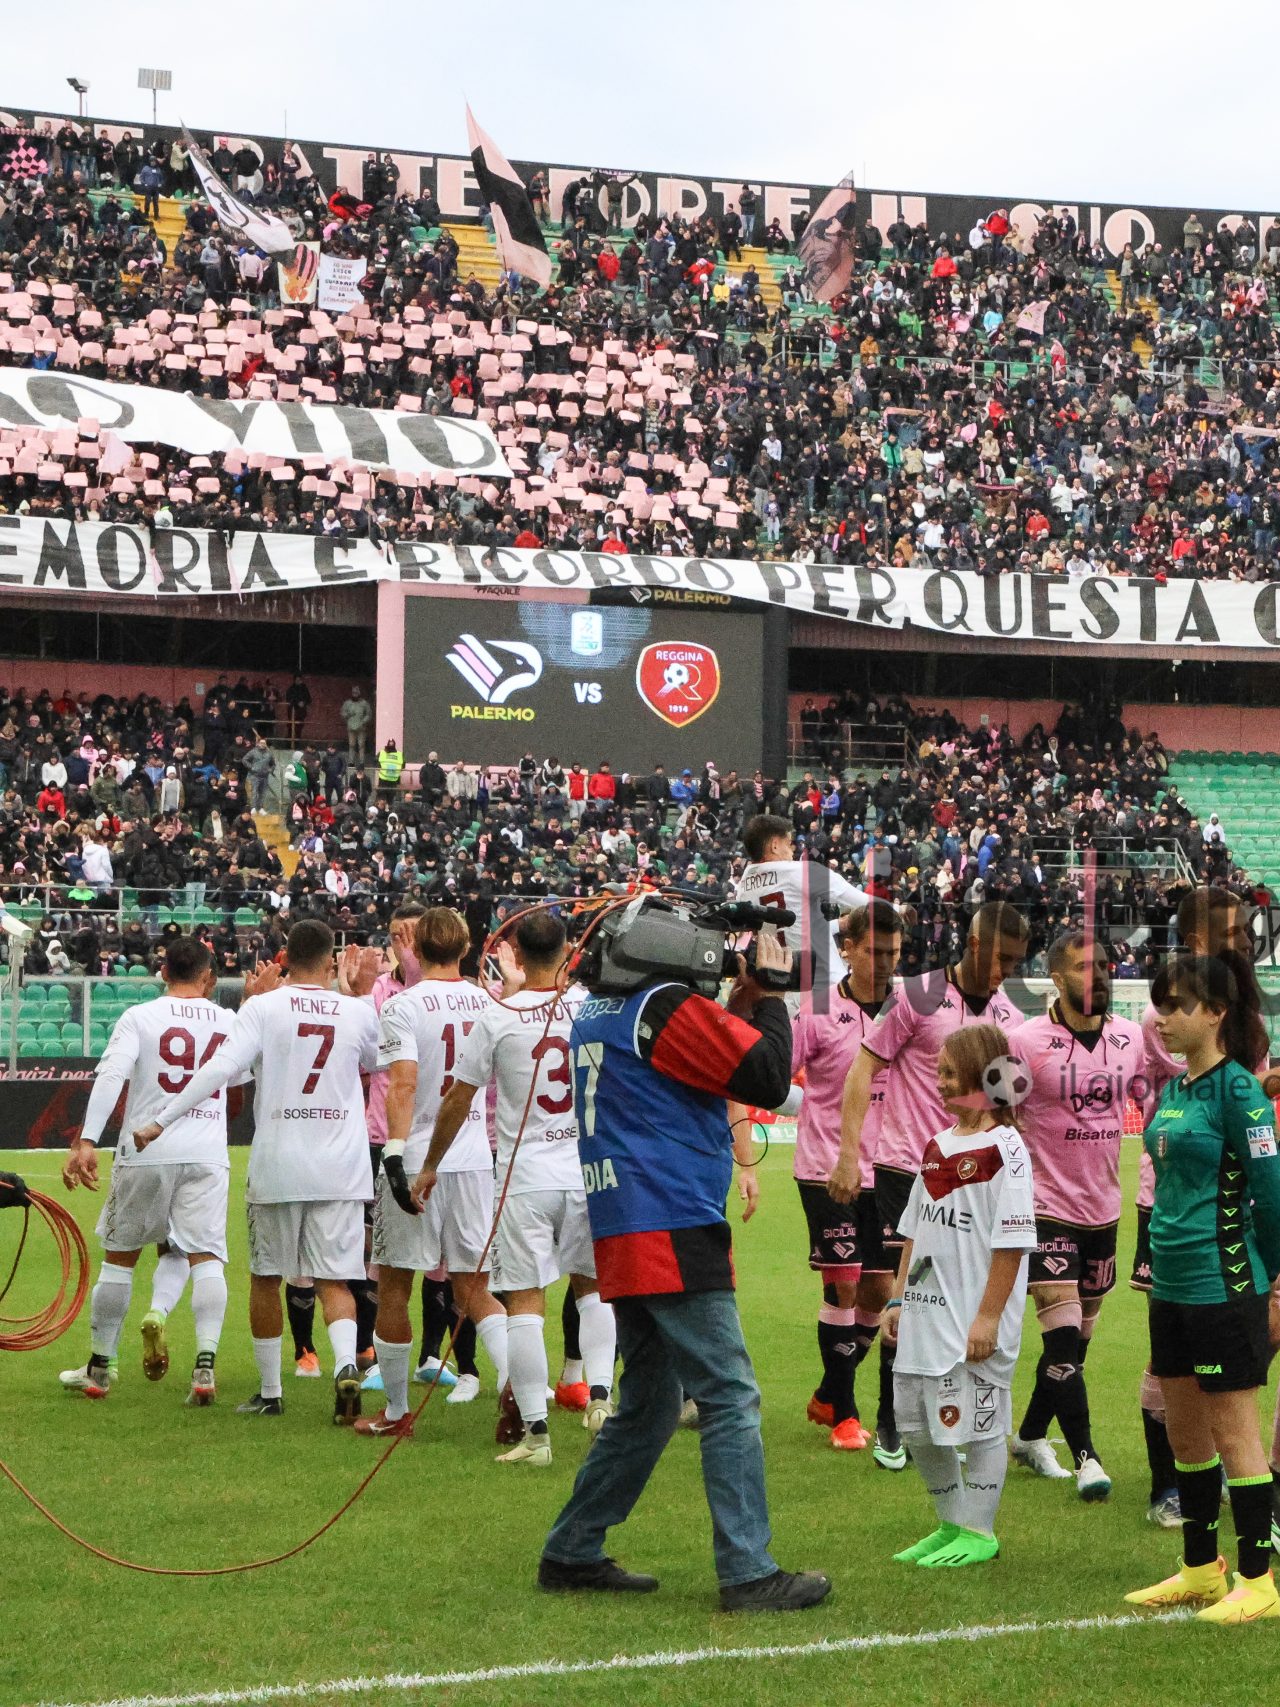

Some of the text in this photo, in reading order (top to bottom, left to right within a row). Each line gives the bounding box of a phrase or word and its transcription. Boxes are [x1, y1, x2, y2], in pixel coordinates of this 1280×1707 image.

[396, 541, 734, 591] RICORDO
[762, 561, 895, 624] PER
[923, 571, 1221, 642] QUESTA
[654, 589, 731, 604] PALERMO
[655, 650, 704, 662] REGGINA
[574, 683, 603, 703] VS
[451, 705, 535, 721] PALERMO
[668, 704, 689, 713] 1914
[290, 997, 340, 1016] MENEZ
[422, 993, 491, 1012] DI CHIAR
[519, 999, 583, 1024] CANOTT
[576, 997, 627, 1021] appa
[171, 1004, 217, 1022] LIOTTI
[298, 1023, 335, 1095] 7
[531, 1035, 574, 1114] 3
[1248, 1127, 1273, 1139] NET
[1082, 1255, 1116, 1290] 30
[904, 1291, 947, 1307] ERRARO
